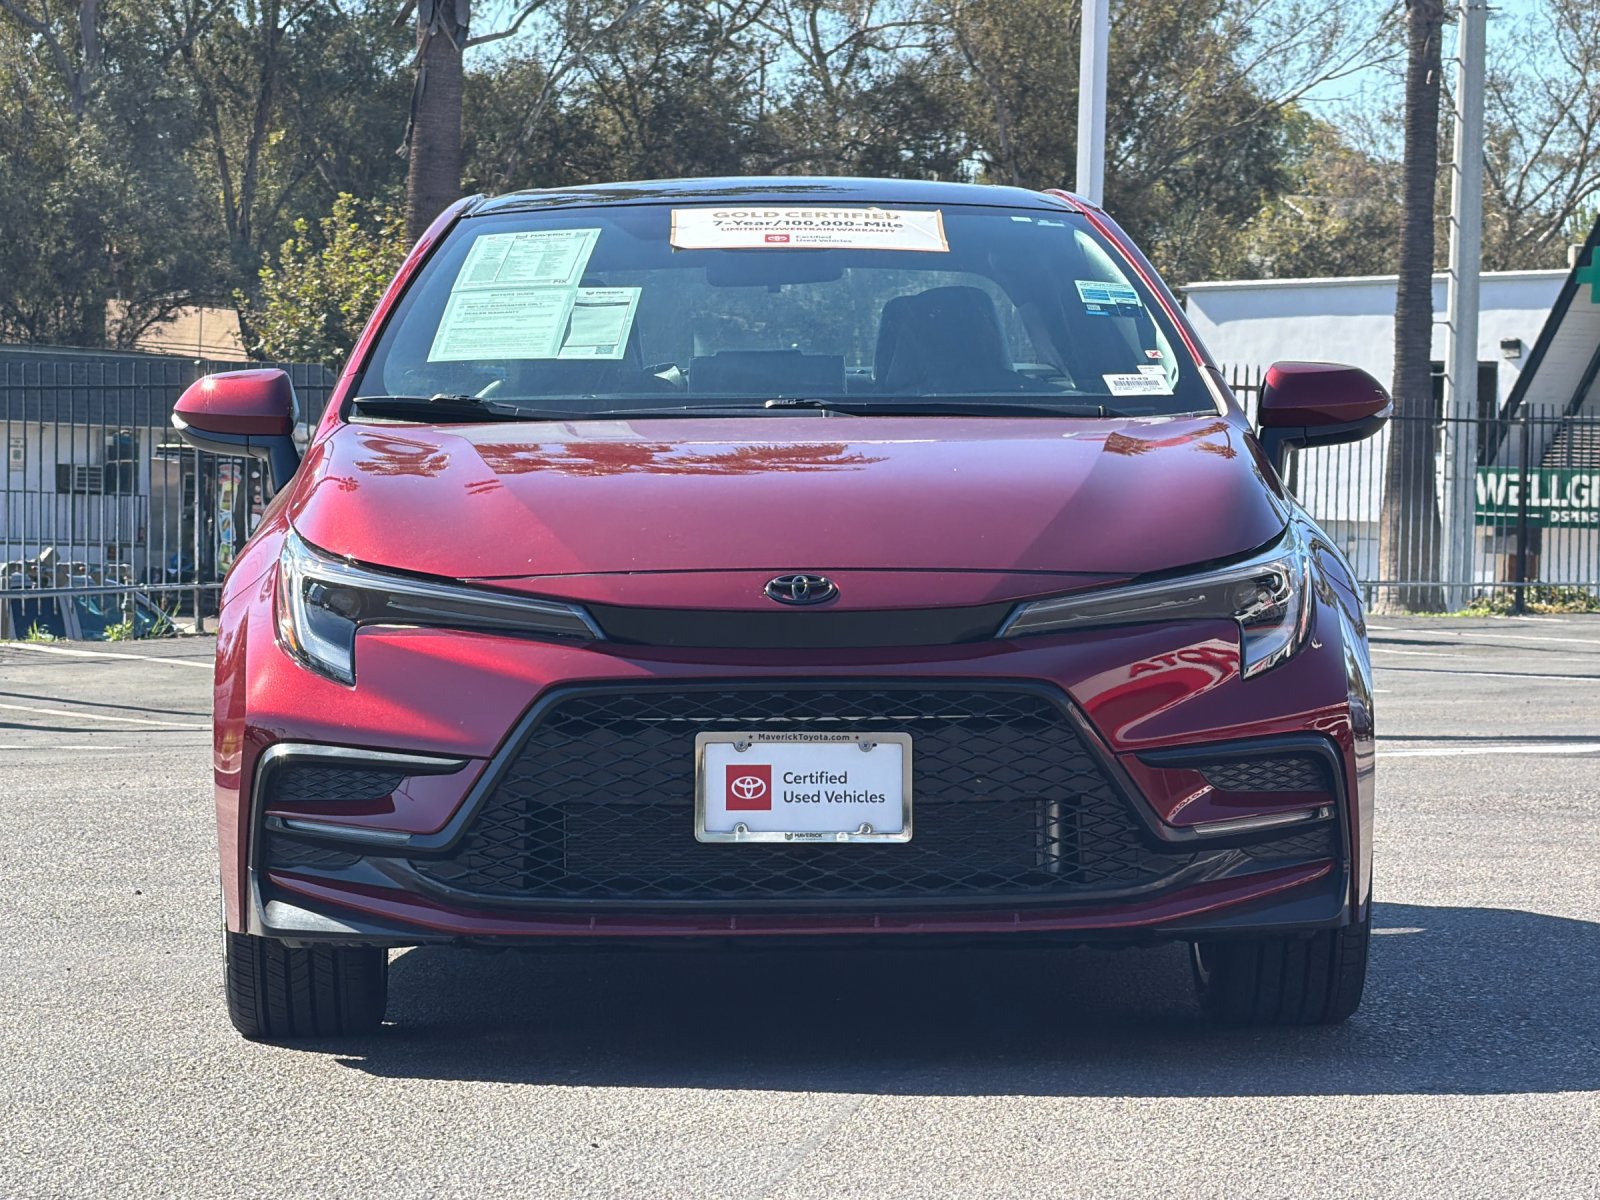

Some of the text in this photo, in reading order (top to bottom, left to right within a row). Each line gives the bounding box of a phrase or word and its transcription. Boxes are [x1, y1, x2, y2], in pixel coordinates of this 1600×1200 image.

[713, 211, 780, 219] GOLD
[712, 220, 904, 228] 7-Year/100,000-Mile
[758, 733, 850, 741] MaverickToyota.com
[783, 771, 848, 785] Certified
[783, 790, 886, 804] Used Vehicles
